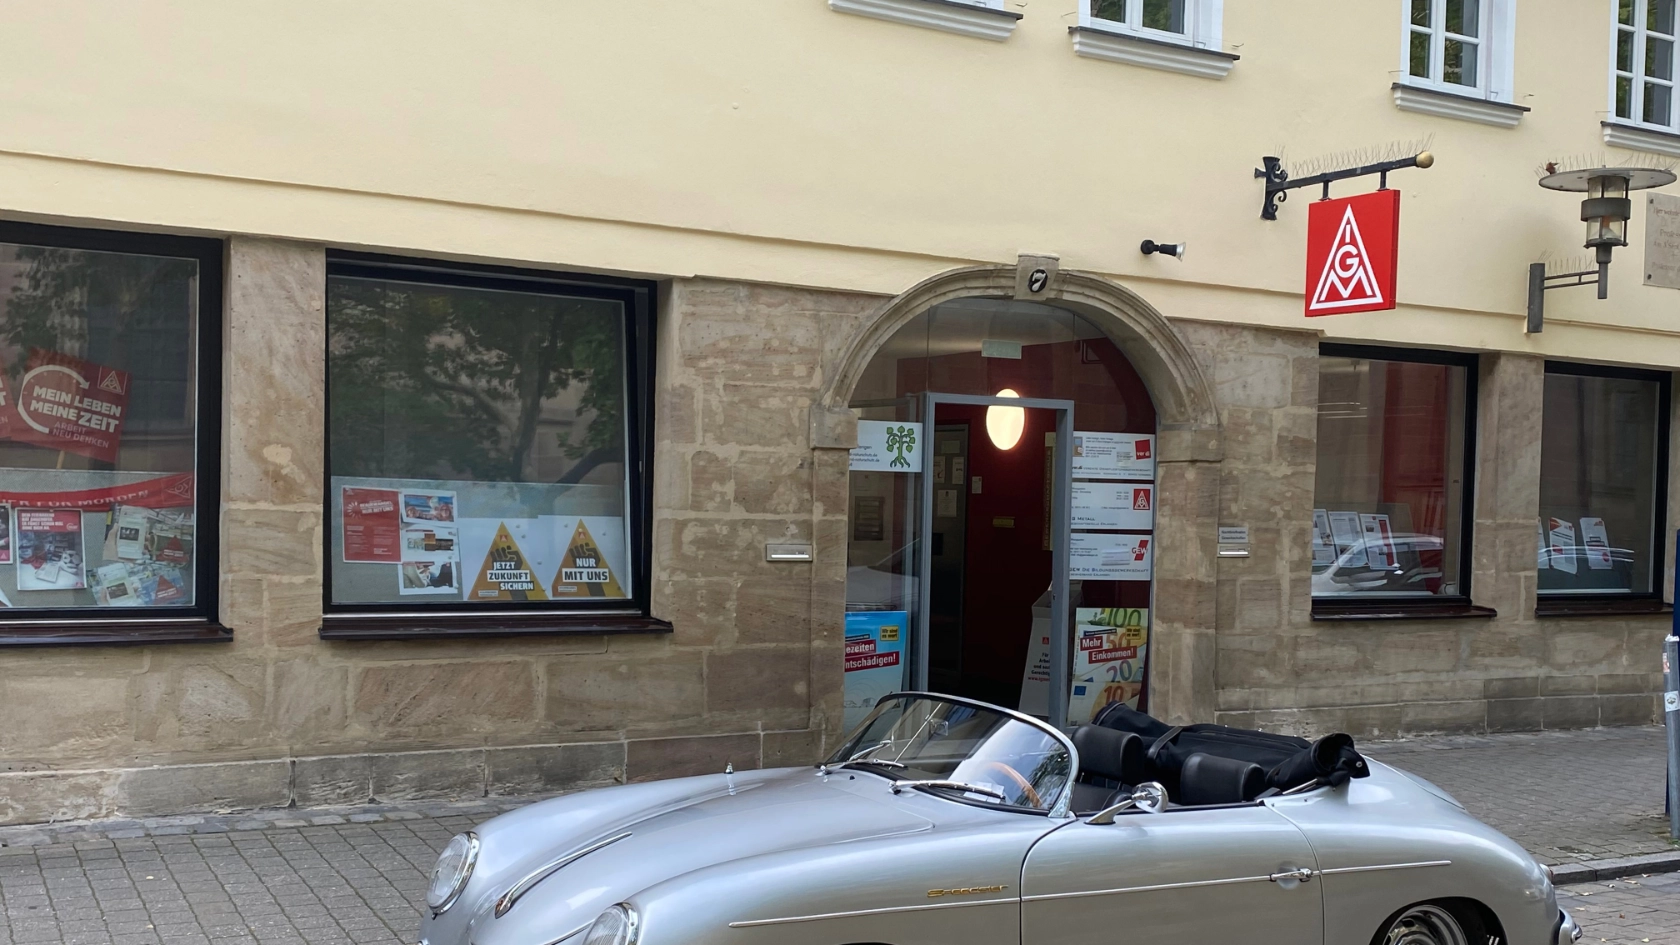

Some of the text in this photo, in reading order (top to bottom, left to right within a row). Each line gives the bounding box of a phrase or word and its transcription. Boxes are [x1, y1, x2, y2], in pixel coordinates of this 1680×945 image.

[1031, 272, 1046, 291] 7
[33, 385, 122, 417] MEIN LEBEN
[30, 399, 78, 421] MEINE
[78, 410, 119, 433] ZEIT
[54, 421, 87, 435] ARBEIT
[52, 428, 110, 449] NEU DENKEN
[493, 561, 515, 570] JETZT
[576, 558, 596, 567] NUR
[488, 572, 529, 580] ZUKUNFT
[564, 571, 608, 580] MIT UNS
[845, 642, 875, 654] ezeiten
[1082, 638, 1102, 648] Mehr
[1092, 648, 1134, 661] Einkommen!
[845, 653, 896, 670] ntschädigen!
[1106, 659, 1132, 683] 20
